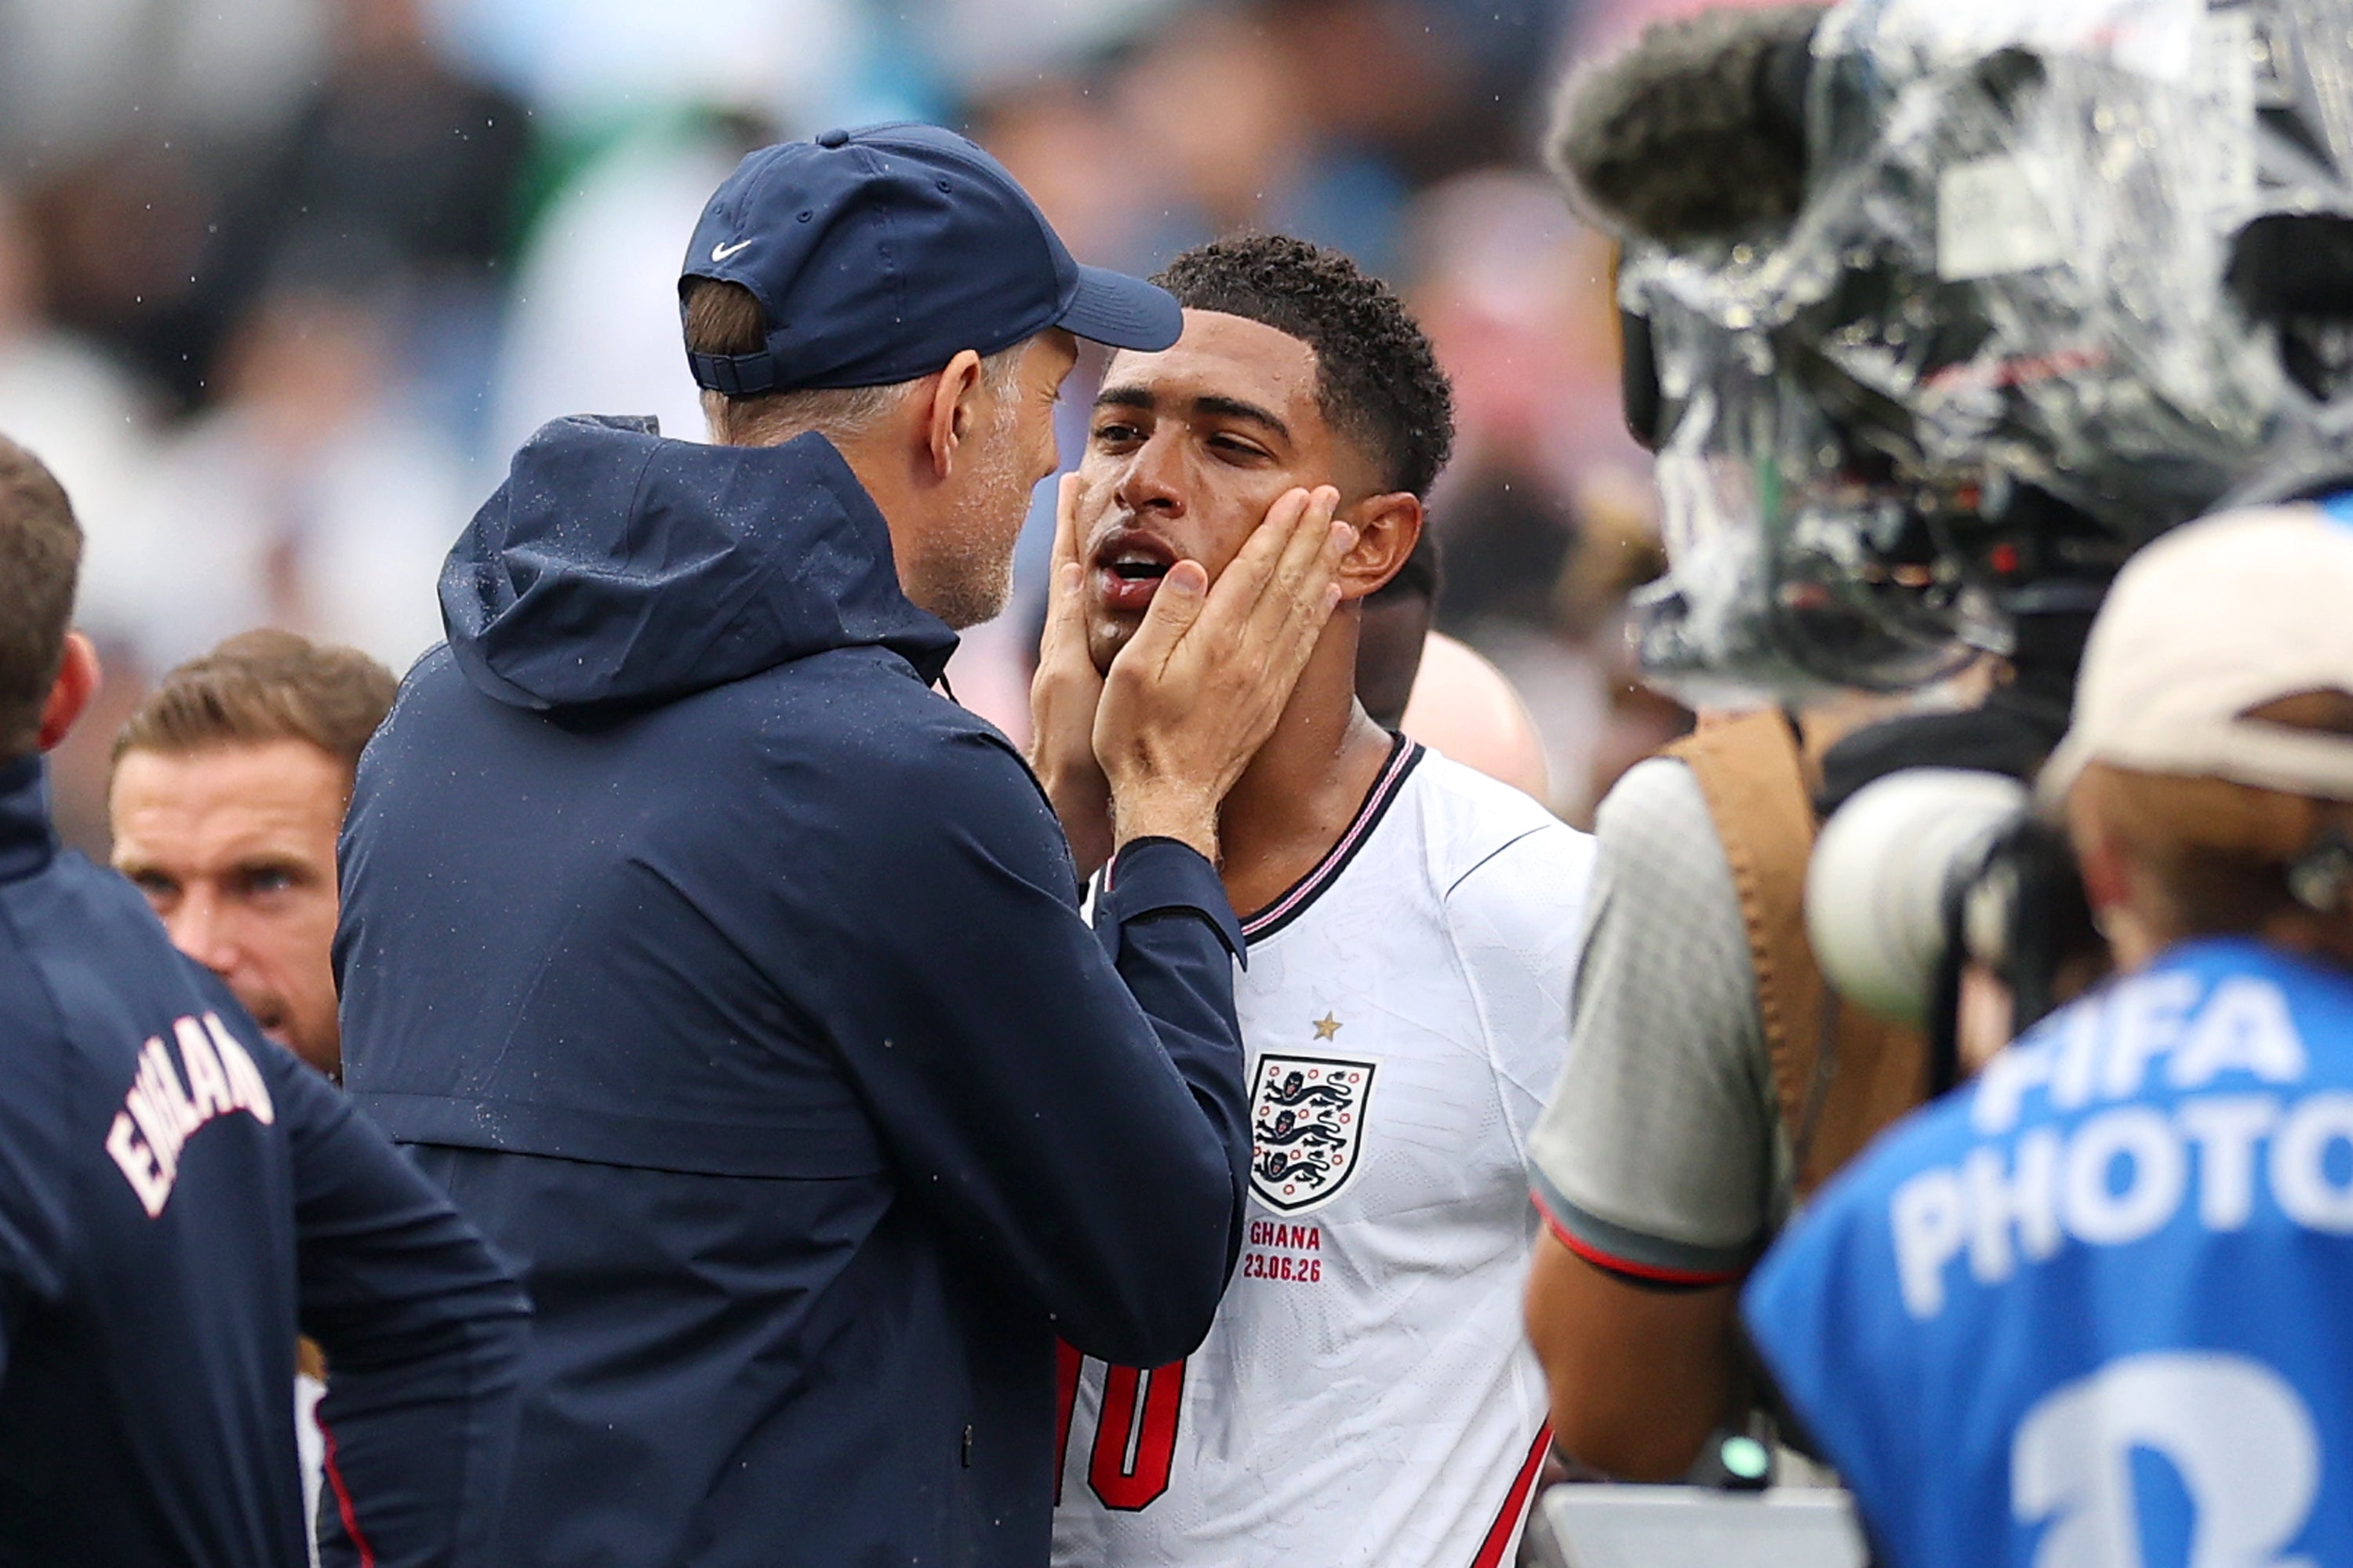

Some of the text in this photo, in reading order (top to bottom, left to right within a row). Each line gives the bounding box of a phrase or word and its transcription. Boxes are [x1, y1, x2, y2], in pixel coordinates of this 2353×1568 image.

[104, 1010, 275, 1218] ENGLAN
[1244, 1253, 1321, 1282] 23.06.26
[1250, 1221, 1320, 1250] GHANA
[1890, 1093, 2353, 1319] PHOTO
[1054, 1335, 1187, 1512] 0
